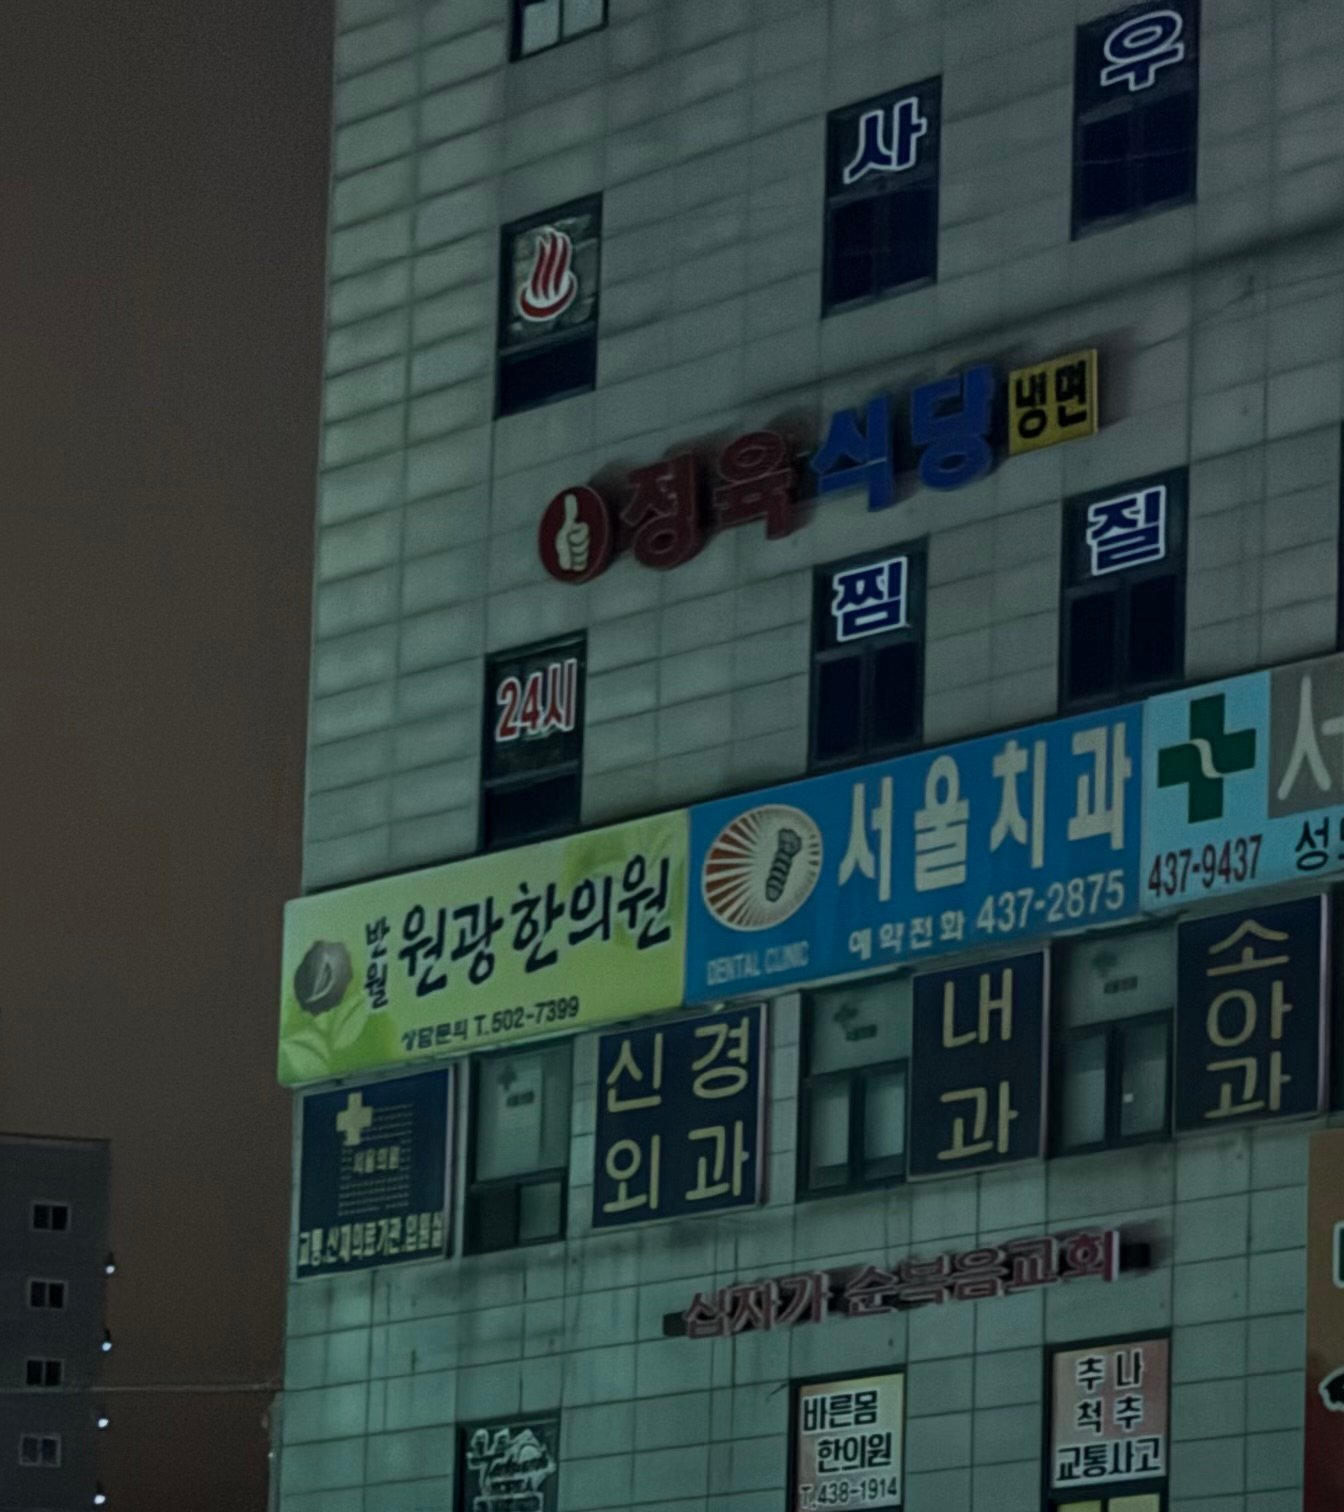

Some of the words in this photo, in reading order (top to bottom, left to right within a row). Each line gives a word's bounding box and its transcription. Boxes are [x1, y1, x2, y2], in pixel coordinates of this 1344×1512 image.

[843, 96, 927, 185] 사
[1100, 9, 1184, 92] 우
[1014, 357, 1090, 439] 냉면
[495, 658, 577, 742] 24시
[838, 722, 1132, 902] 서울치과
[1148, 834, 1263, 897] 437-9437
[399, 854, 672, 997] 원광한의원
[848, 911, 964, 960] 예약전화
[976, 870, 1125, 935] 437-2875
[707, 949, 761, 985] DENTAL
[765, 941, 809, 975] CLINIC
[401, 1019, 468, 1053] 상담문의
[474, 996, 580, 1039] T.502-7399
[1205, 920, 1292, 1118] 소아과
[607, 1018, 751, 1113] 신경
[937, 968, 1018, 1160] 내과
[602, 1121, 750, 1213] 외과
[1076, 1350, 1144, 1391] 추나
[802, 1391, 878, 1433] 바른몸
[816, 1433, 893, 1473] 한의원
[1076, 1396, 1144, 1433] 척추
[801, 1480, 899, 1510] T.438-1914
[1056, 1437, 1160, 1481] 교통사고
